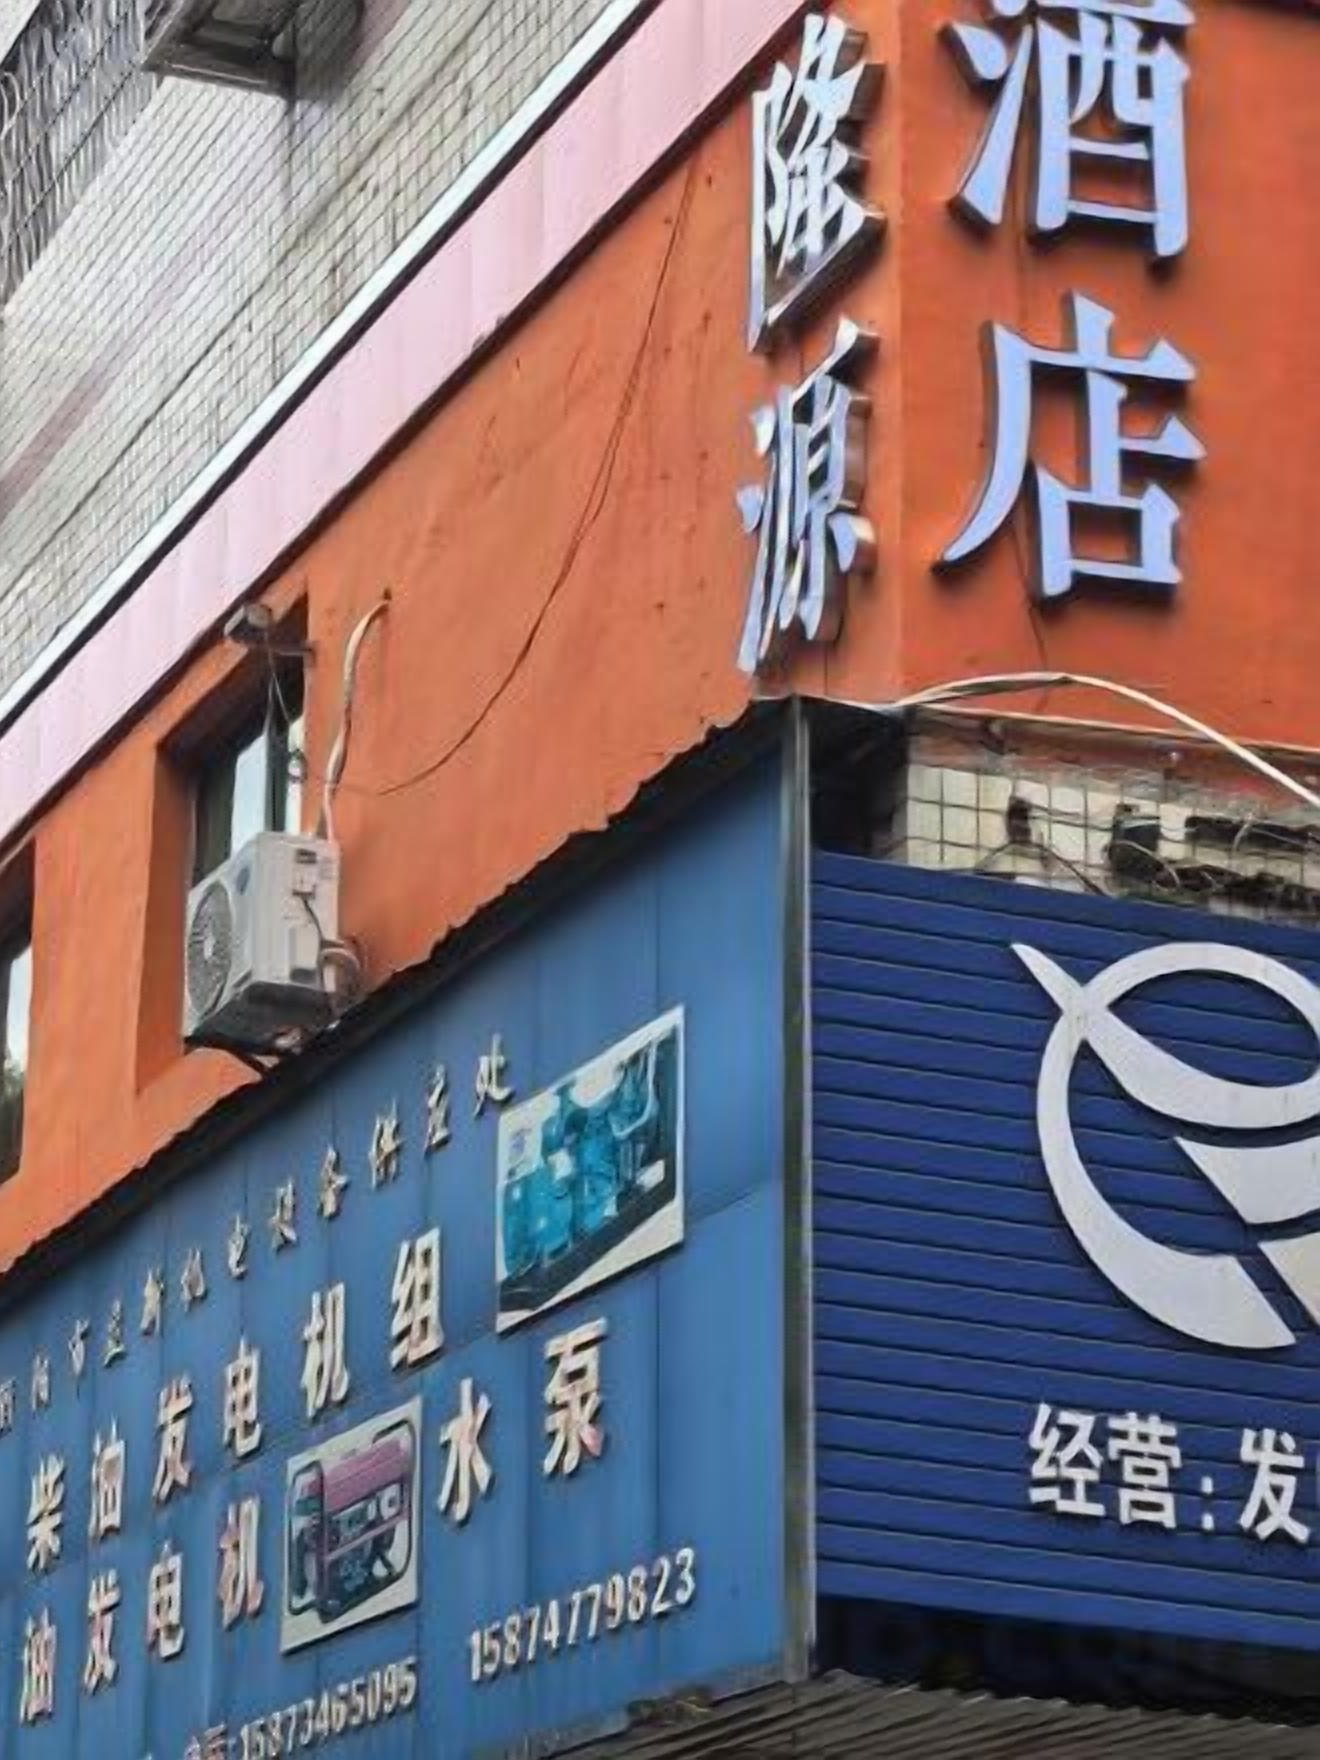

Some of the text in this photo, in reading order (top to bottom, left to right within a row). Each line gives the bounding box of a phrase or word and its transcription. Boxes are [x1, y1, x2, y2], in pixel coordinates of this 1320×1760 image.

[936, 0, 1207, 599] 酒店
[26, 1229, 444, 1571] 柴油发电机组
[437, 1318, 607, 1525] 水泵
[1027, 1403, 1320, 1543] 经营：发
[471, 1547, 696, 1682] 15874779823
